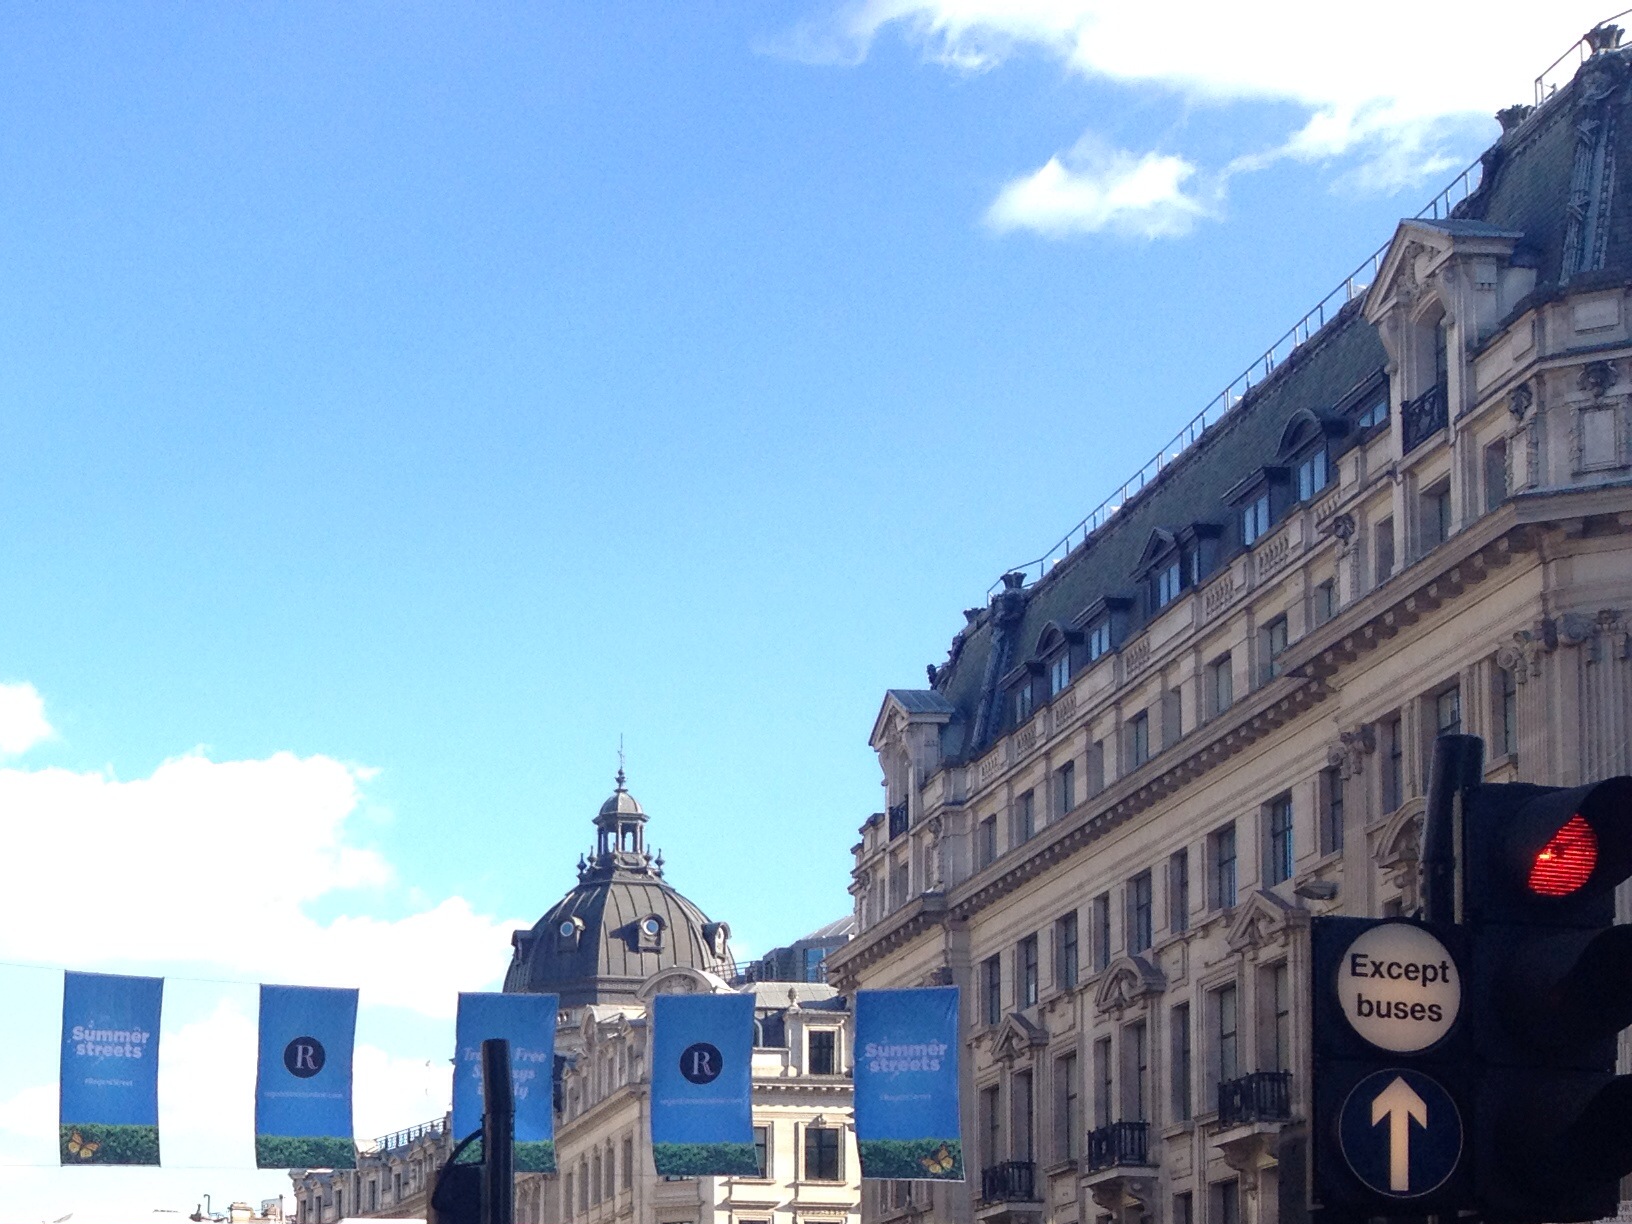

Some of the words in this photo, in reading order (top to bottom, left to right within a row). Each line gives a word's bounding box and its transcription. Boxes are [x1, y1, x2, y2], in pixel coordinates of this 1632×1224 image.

[1350, 953, 1450, 987] Except
[1357, 993, 1443, 1022] buses
[72, 1025, 150, 1044] Summer
[76, 1042, 142, 1059] streets
[294, 1044, 319, 1070] R
[515, 1047, 547, 1063] Free
[865, 1043, 948, 1058] Summer
[691, 1051, 715, 1076] R
[869, 1056, 941, 1073] streets
